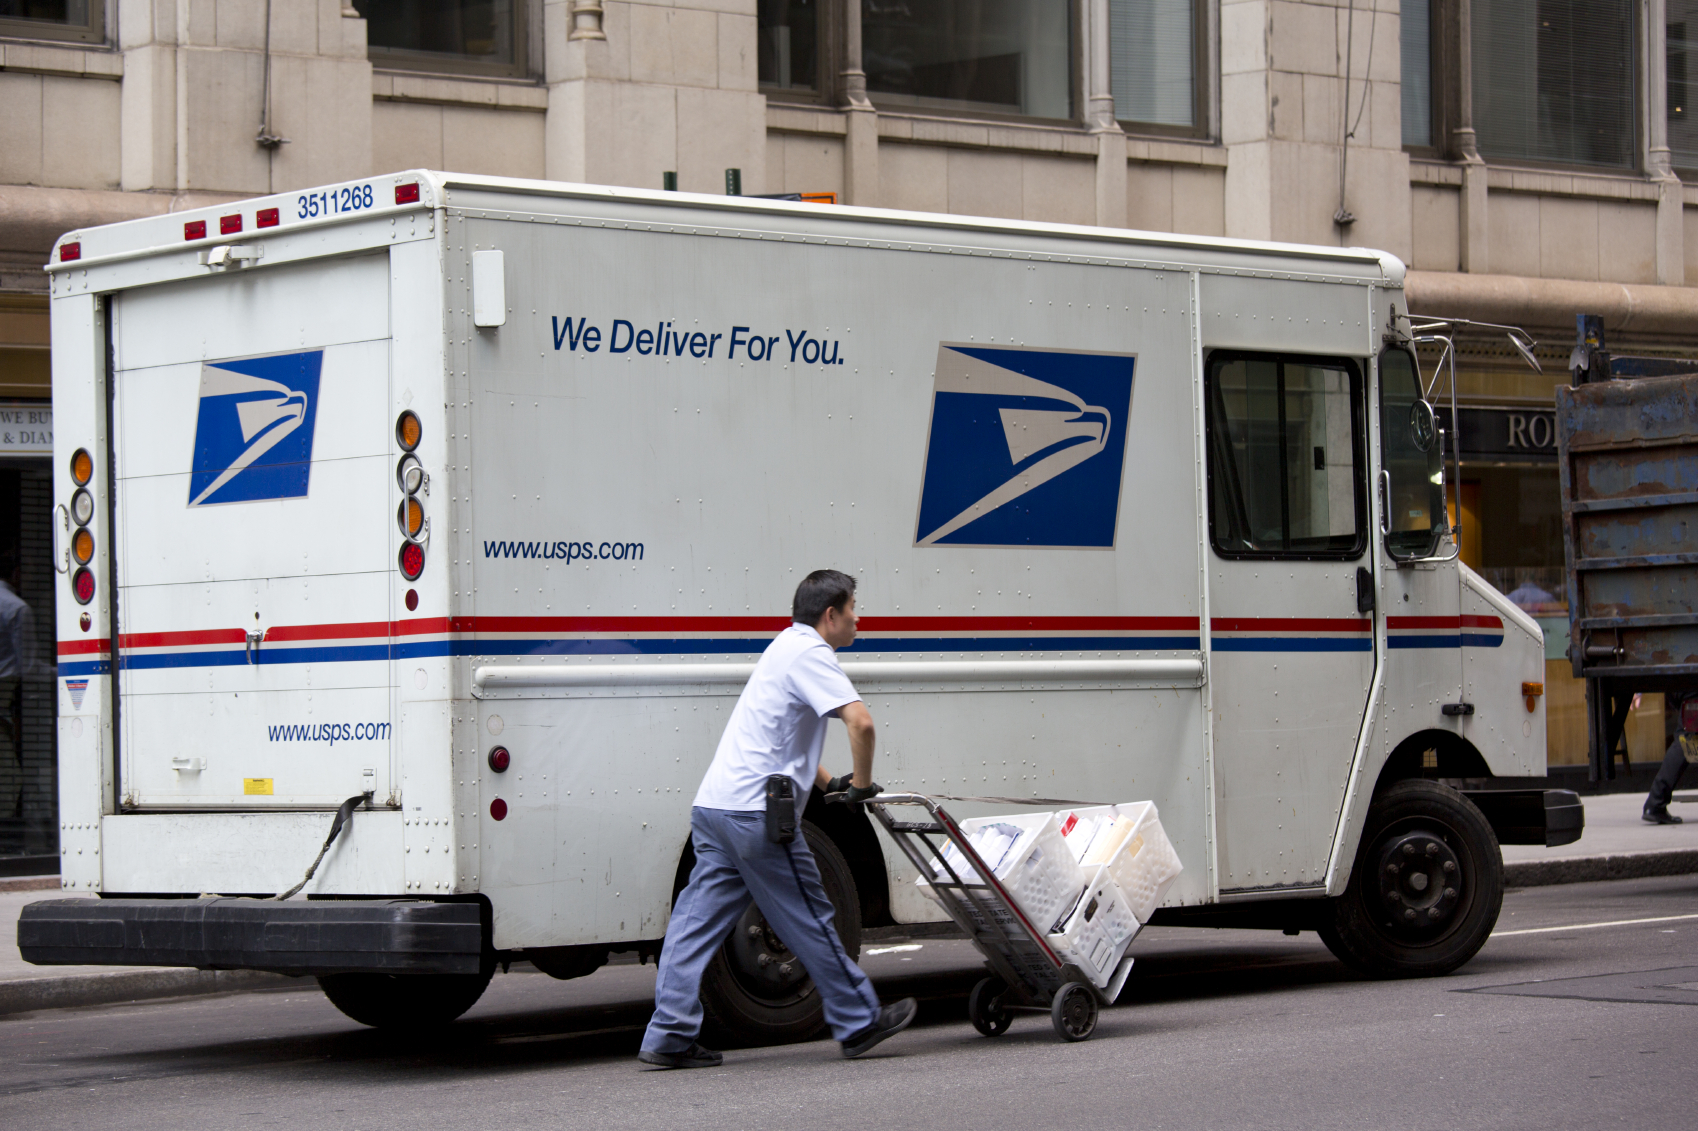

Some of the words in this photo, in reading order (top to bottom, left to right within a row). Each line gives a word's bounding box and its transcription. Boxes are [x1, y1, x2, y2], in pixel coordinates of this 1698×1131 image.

[298, 184, 374, 220] 3511268
[552, 316, 602, 353] We
[609, 319, 723, 358] Deliver
[728, 326, 780, 361] For
[785, 329, 845, 365] You.
[1, 411, 24, 424] WE
[3, 432, 15, 444] &
[483, 539, 645, 566] www.usps.com
[268, 721, 393, 747] www.usps.com
